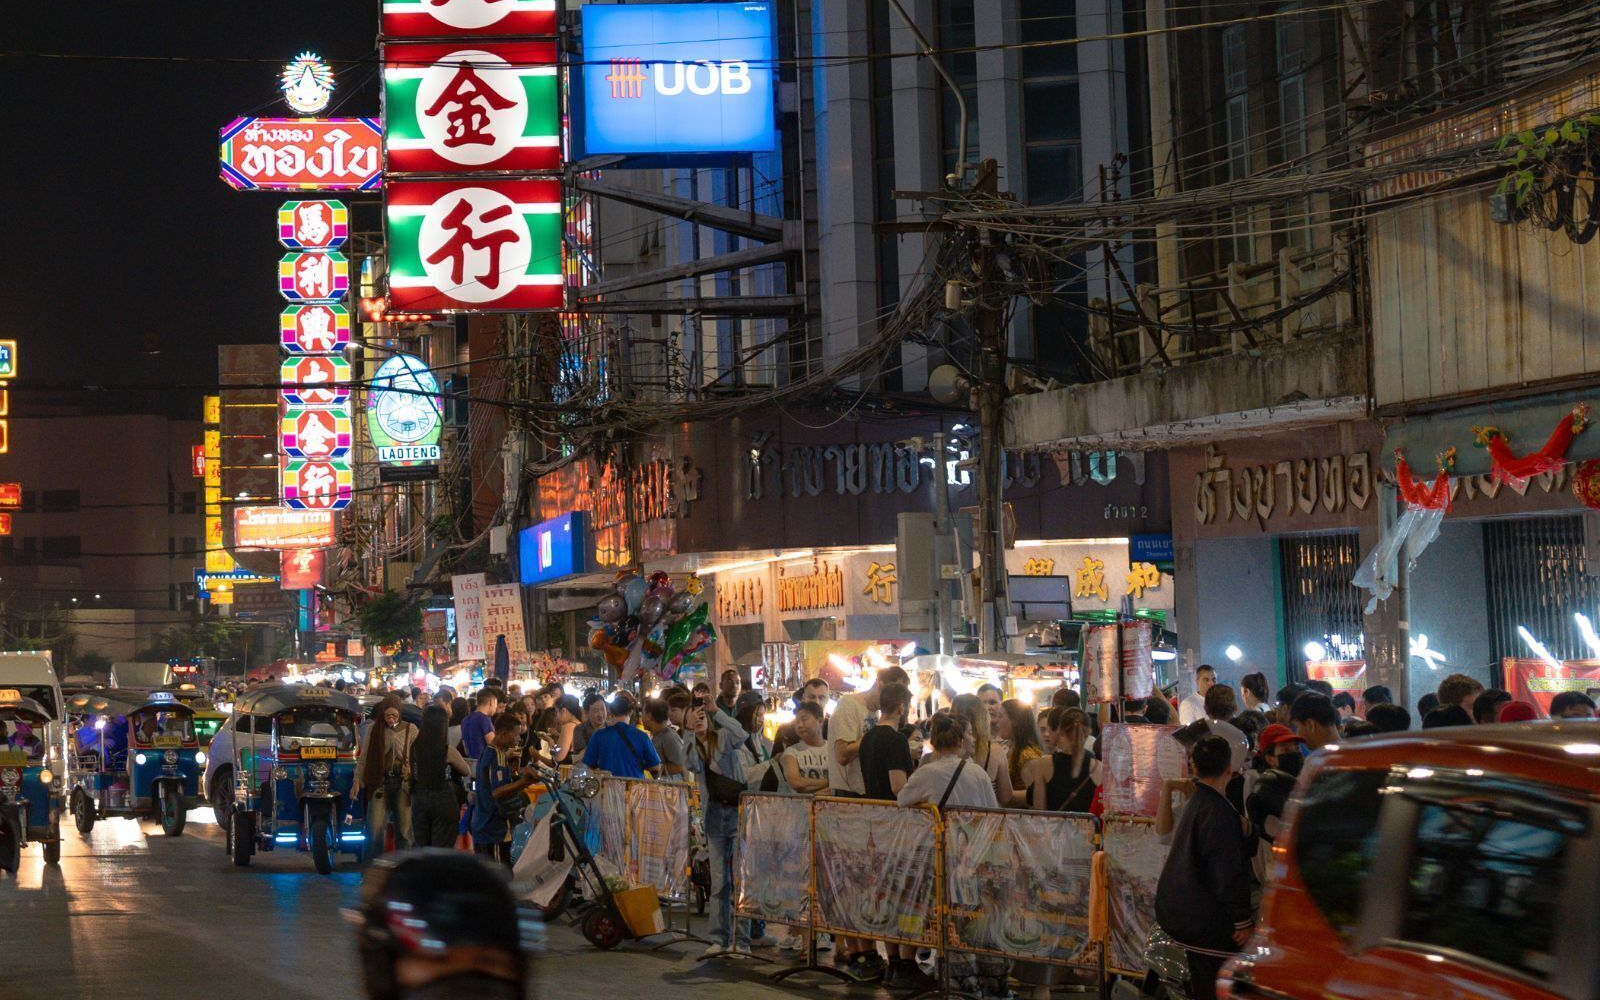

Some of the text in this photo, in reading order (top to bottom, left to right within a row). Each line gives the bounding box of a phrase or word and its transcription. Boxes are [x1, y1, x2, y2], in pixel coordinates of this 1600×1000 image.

[654, 59, 752, 96] UOB
[243, 122, 314, 143] ห้างทอง
[382, 446, 437, 460] LAOTENG
[1194, 443, 1373, 525] ห้างขายทอ
[1141, 505, 1148, 518] 2
